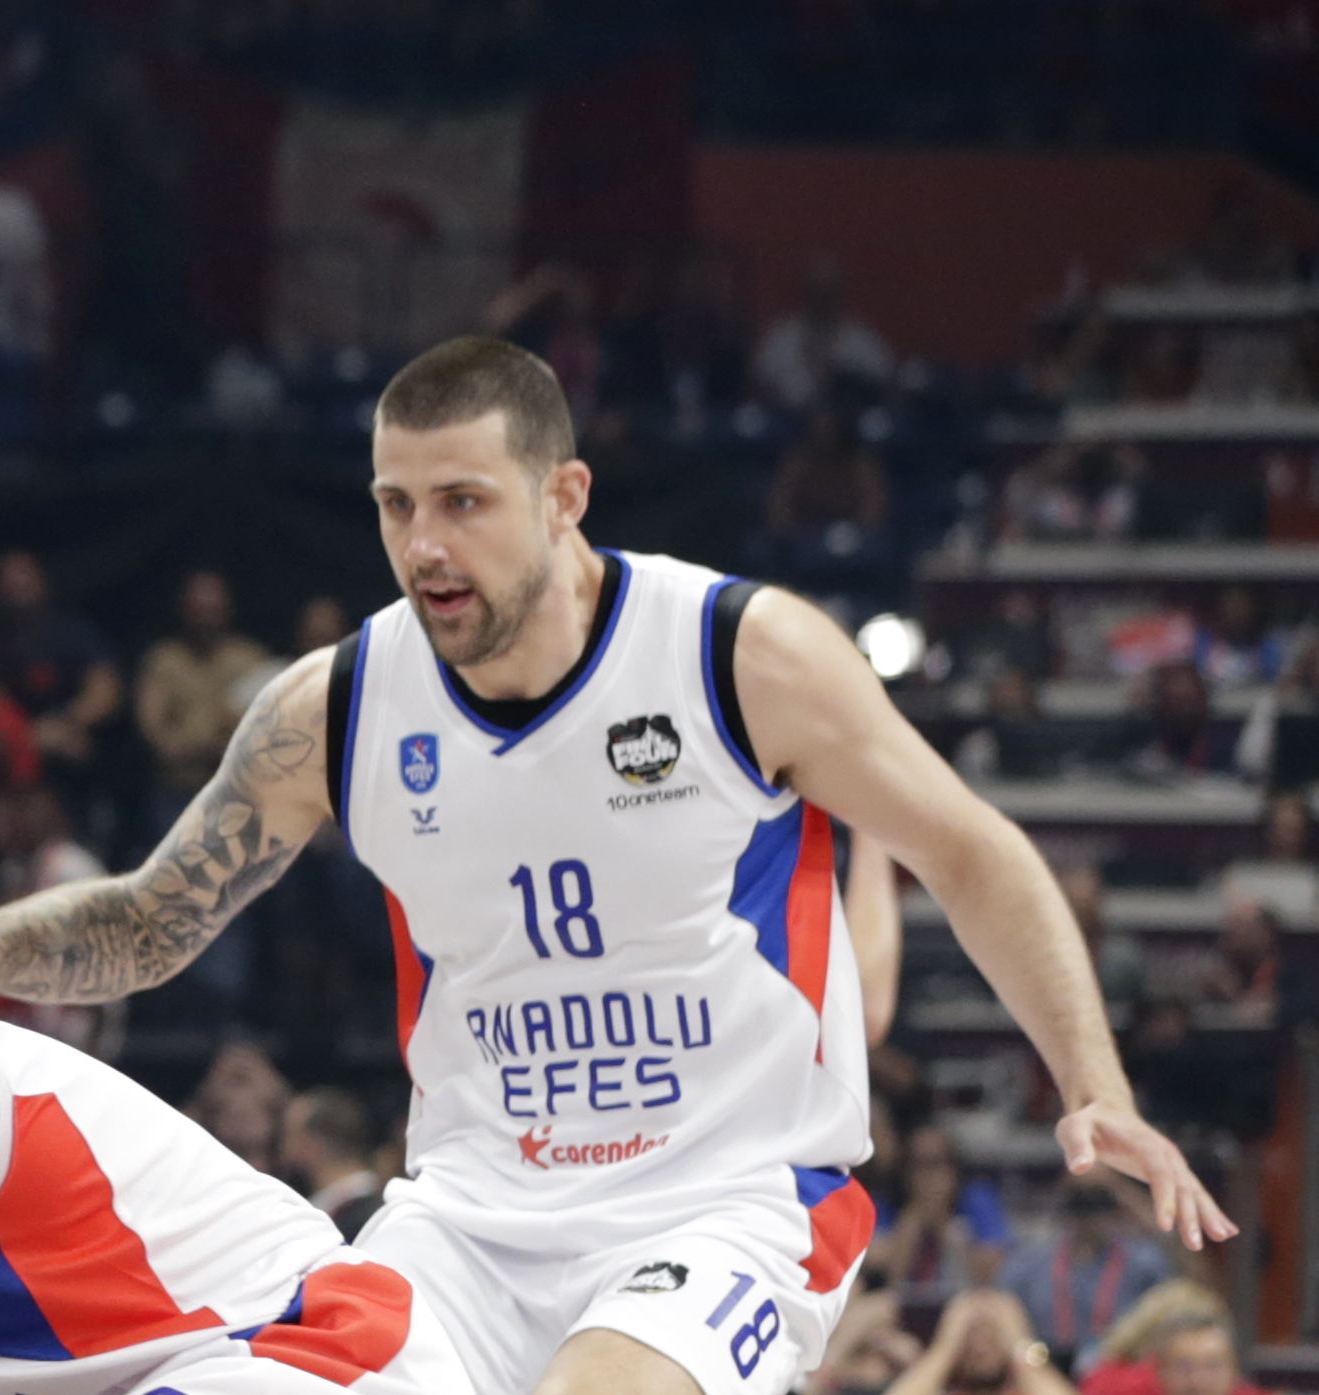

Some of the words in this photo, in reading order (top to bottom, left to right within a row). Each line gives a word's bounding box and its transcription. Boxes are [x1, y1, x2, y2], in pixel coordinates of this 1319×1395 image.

[508, 858, 605, 960] 18
[466, 991, 712, 1066] ANADOLU
[501, 1057, 682, 1117] EFES
[705, 1270, 780, 1379] 18
